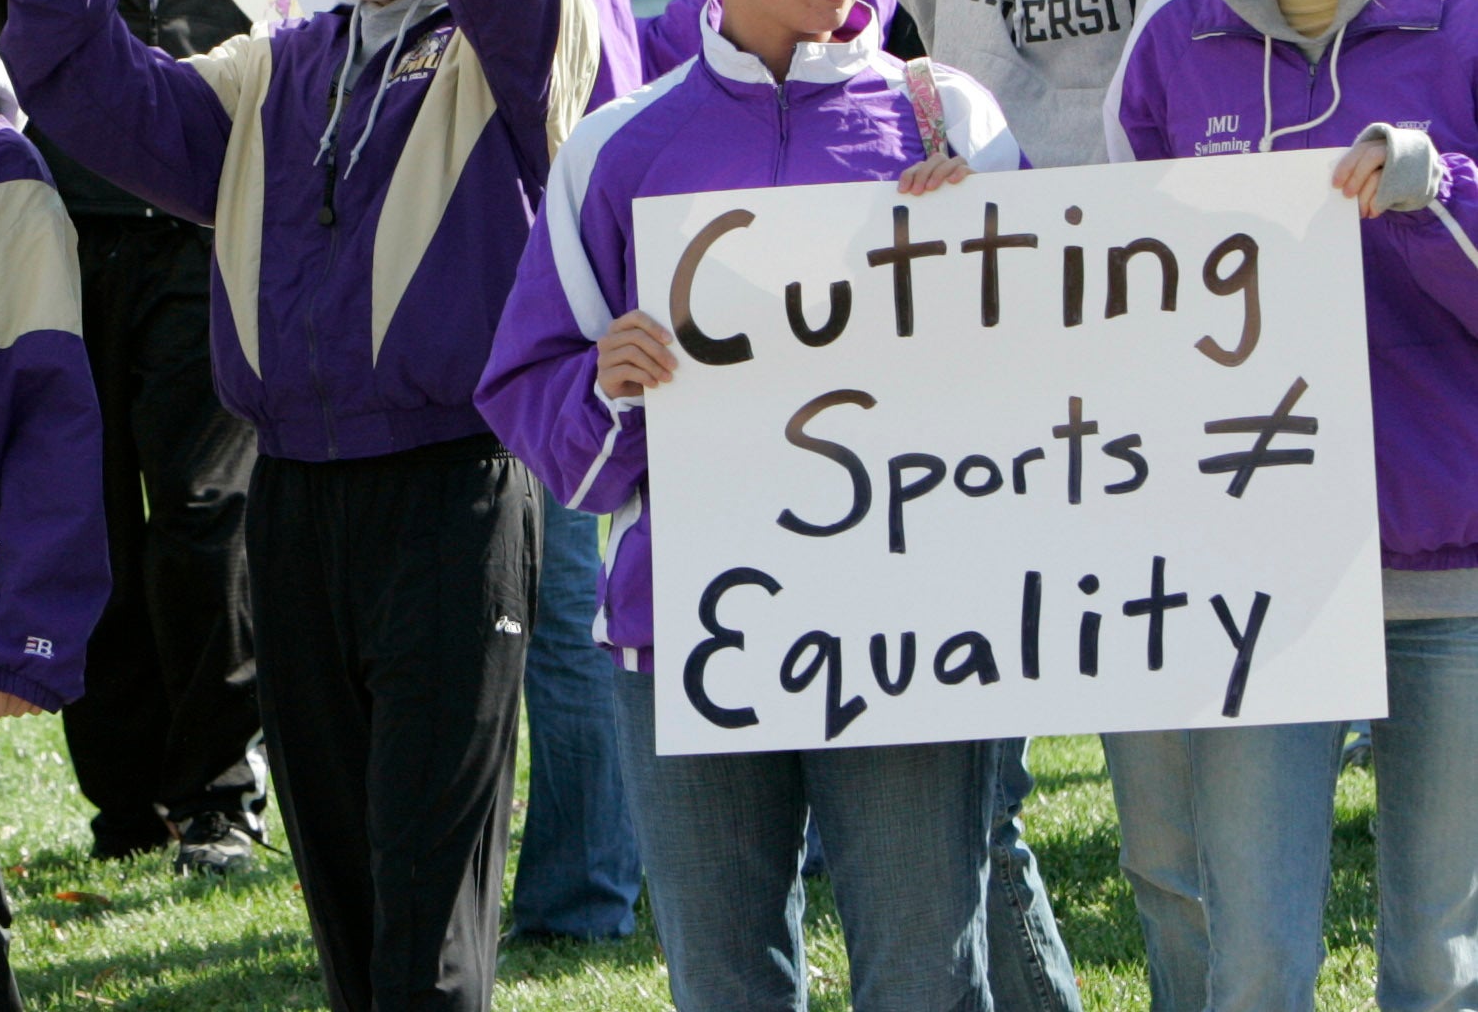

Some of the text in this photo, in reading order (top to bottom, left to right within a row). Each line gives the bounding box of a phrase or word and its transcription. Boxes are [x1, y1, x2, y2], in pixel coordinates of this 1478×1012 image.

[1194, 137, 1251, 156] Swimming
[1205, 115, 1239, 137] JMU
[669, 202, 1262, 367] Cutting
[776, 388, 1150, 554] Sports
[682, 555, 1273, 742] Equality
